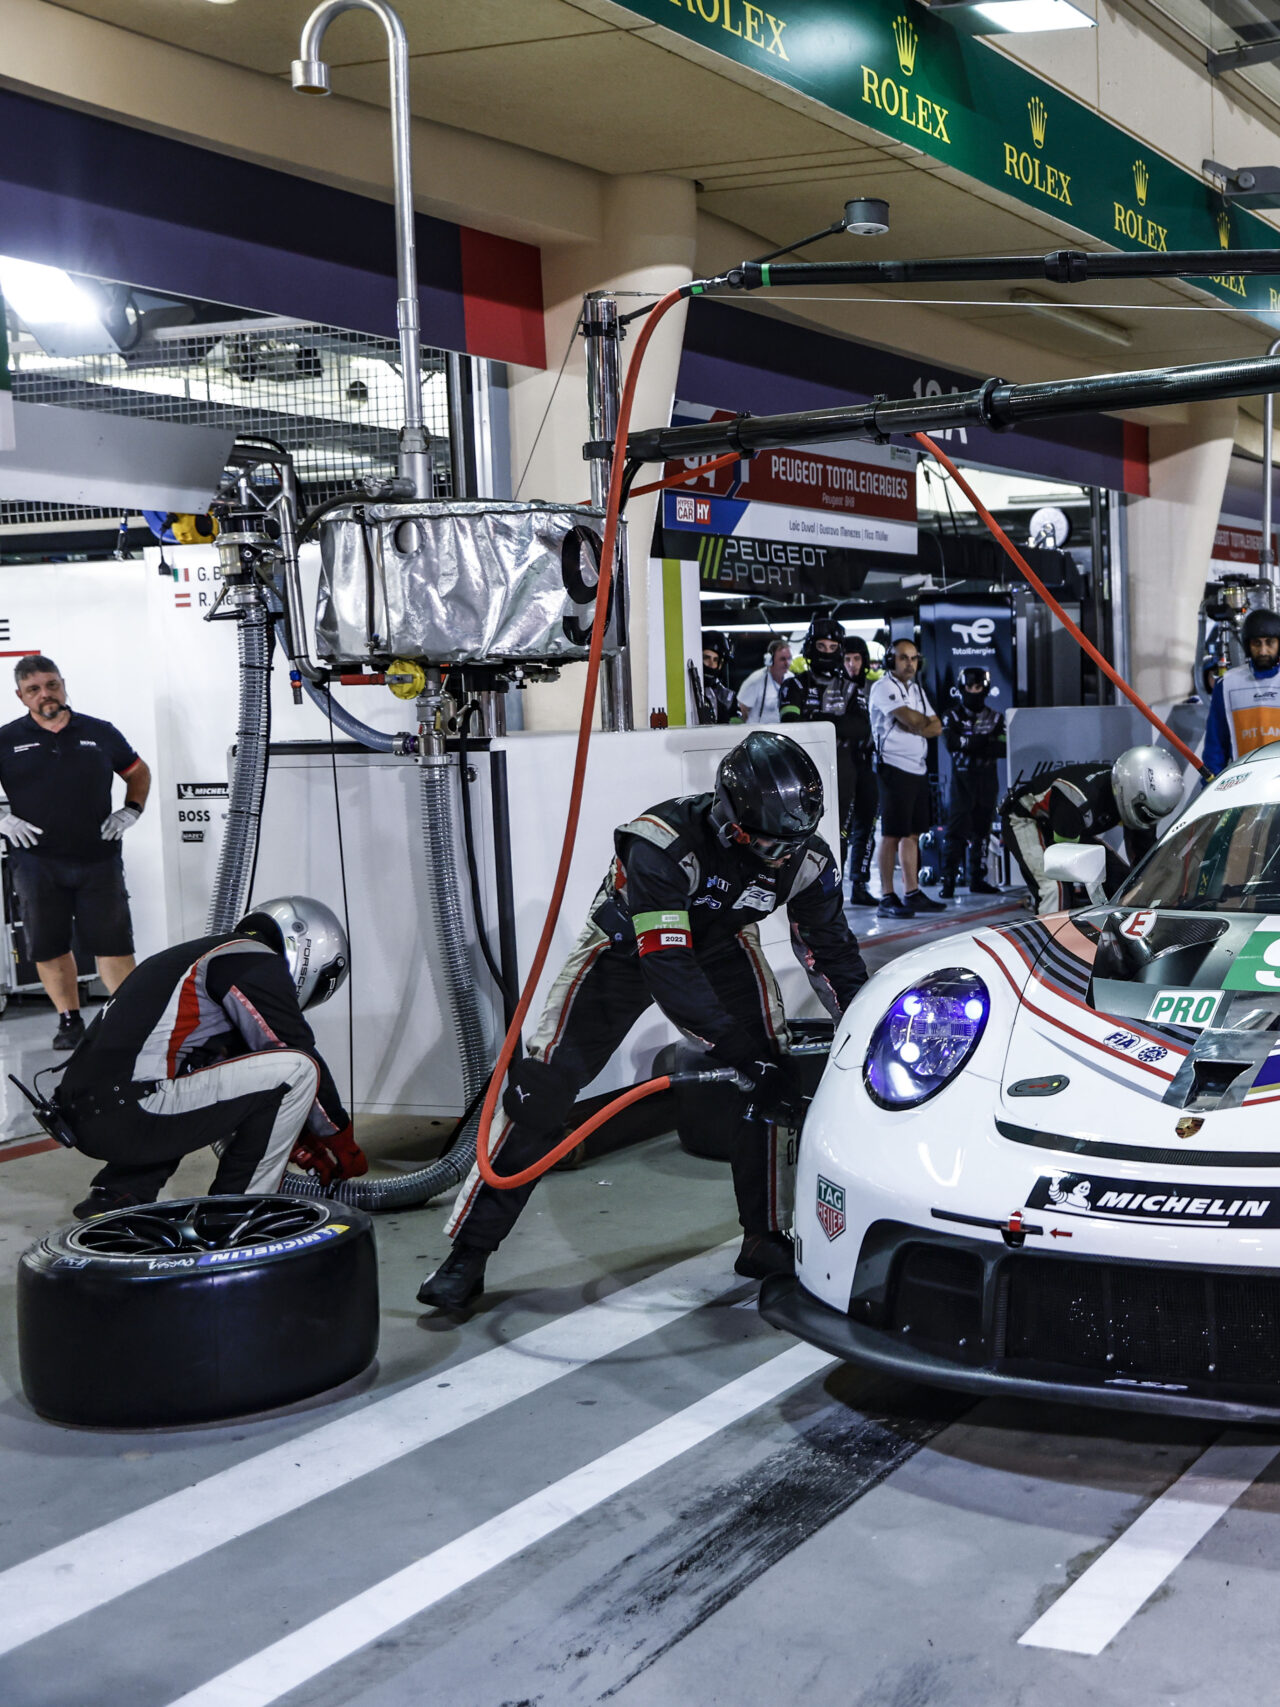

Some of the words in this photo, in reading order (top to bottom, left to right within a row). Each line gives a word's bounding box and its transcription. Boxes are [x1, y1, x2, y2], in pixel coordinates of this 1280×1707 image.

[860, 64, 951, 144] ROLEX
[1003, 142, 1073, 206] ROLEX
[1113, 202, 1168, 252] ROLEX
[771, 455, 824, 487] PEUGEOT
[826, 464, 908, 500] TOTALENERGIES
[677, 498, 694, 511] HYPER
[677, 507, 694, 522] CAR
[696, 503, 710, 521] HY
[724, 538, 828, 568] PEUGEOT
[197, 567, 210, 582] G.
[720, 562, 795, 587] SPORT
[198, 592, 211, 607] R.
[951, 647, 996, 656] TotalEnergies
[1242, 727, 1257, 740] PIT
[179, 810, 211, 822] BOSS
[1125, 911, 1152, 937] E
[296, 938, 312, 996] PORSCH
[1151, 996, 1217, 1023] PRO
[1106, 1031, 1136, 1050] FIA
[820, 1182, 842, 1209] TAG
[1096, 1190, 1271, 1217] MICHELIN
[818, 1202, 843, 1235] HEUER
[210, 1231, 322, 1263] MICHELIN
